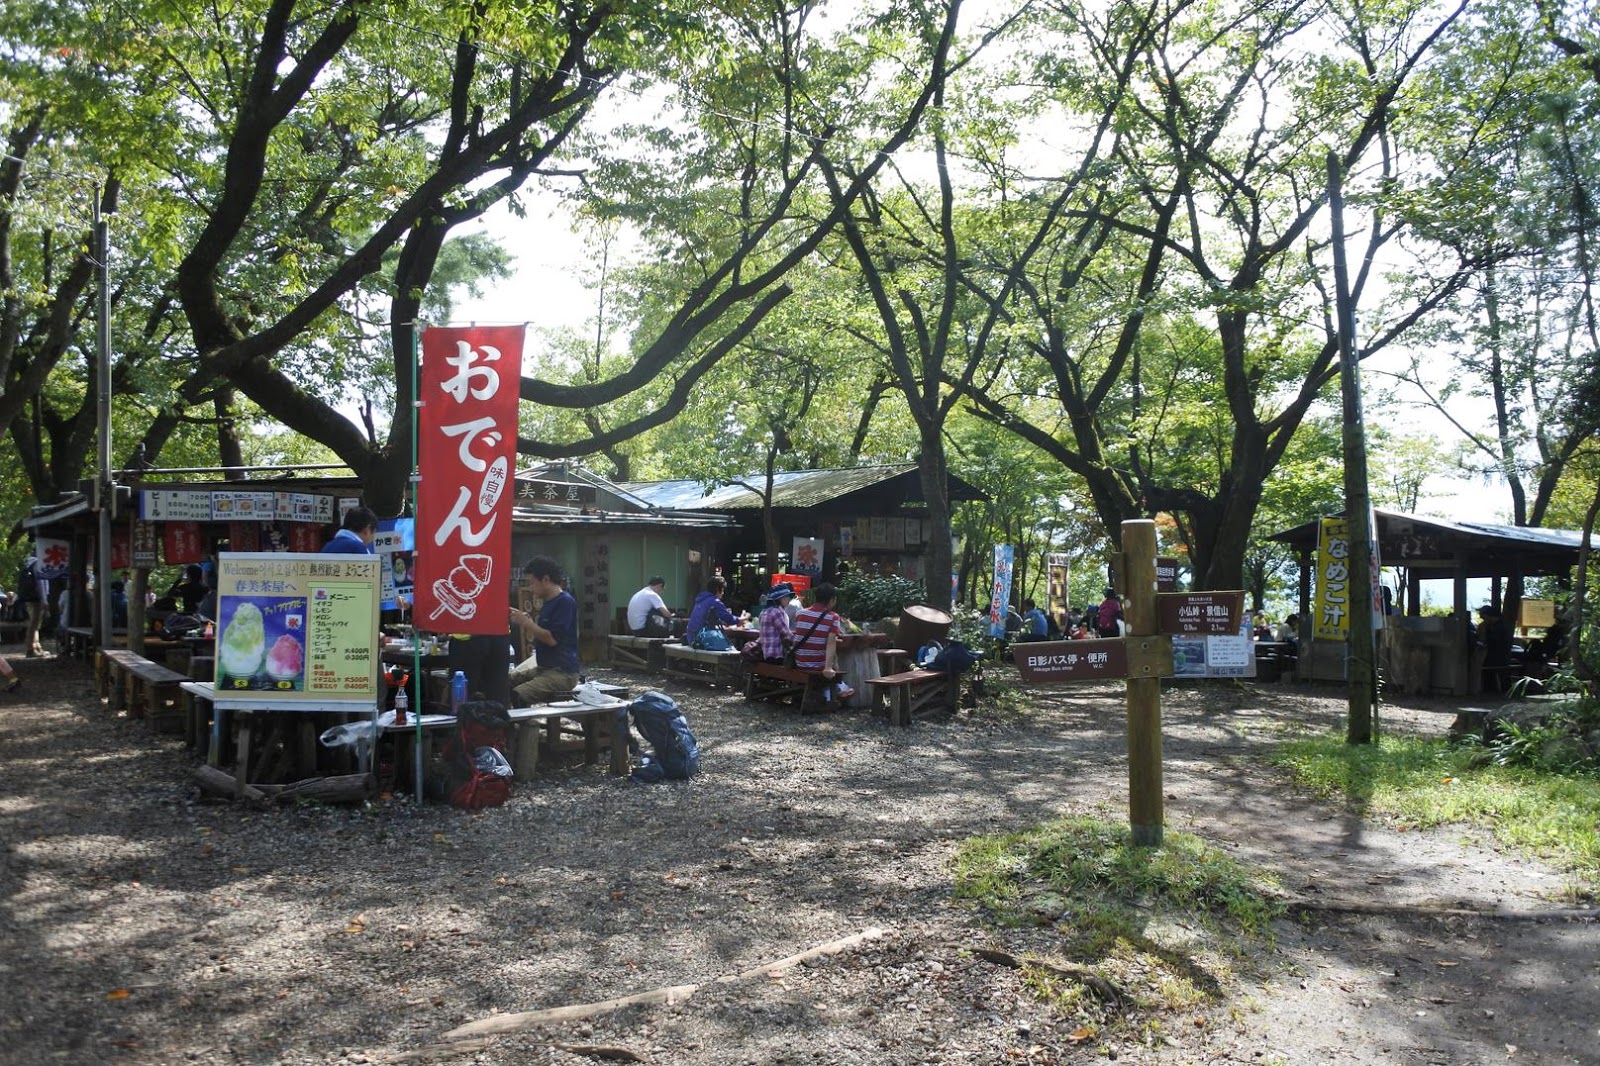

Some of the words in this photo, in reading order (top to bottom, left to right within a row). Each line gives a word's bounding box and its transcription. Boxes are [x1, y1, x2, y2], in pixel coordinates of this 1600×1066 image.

[434, 340, 502, 548] おでん
[480, 466, 505, 508] 味自慢
[518, 482, 580, 501] 美茶屋
[151, 491, 160, 517] ビール
[375, 536, 402, 547] かき氷
[43, 543, 69, 566] 氷
[235, 579, 297, 593] 春美茶屋へ
[1324, 537, 1349, 627] なめこ汁
